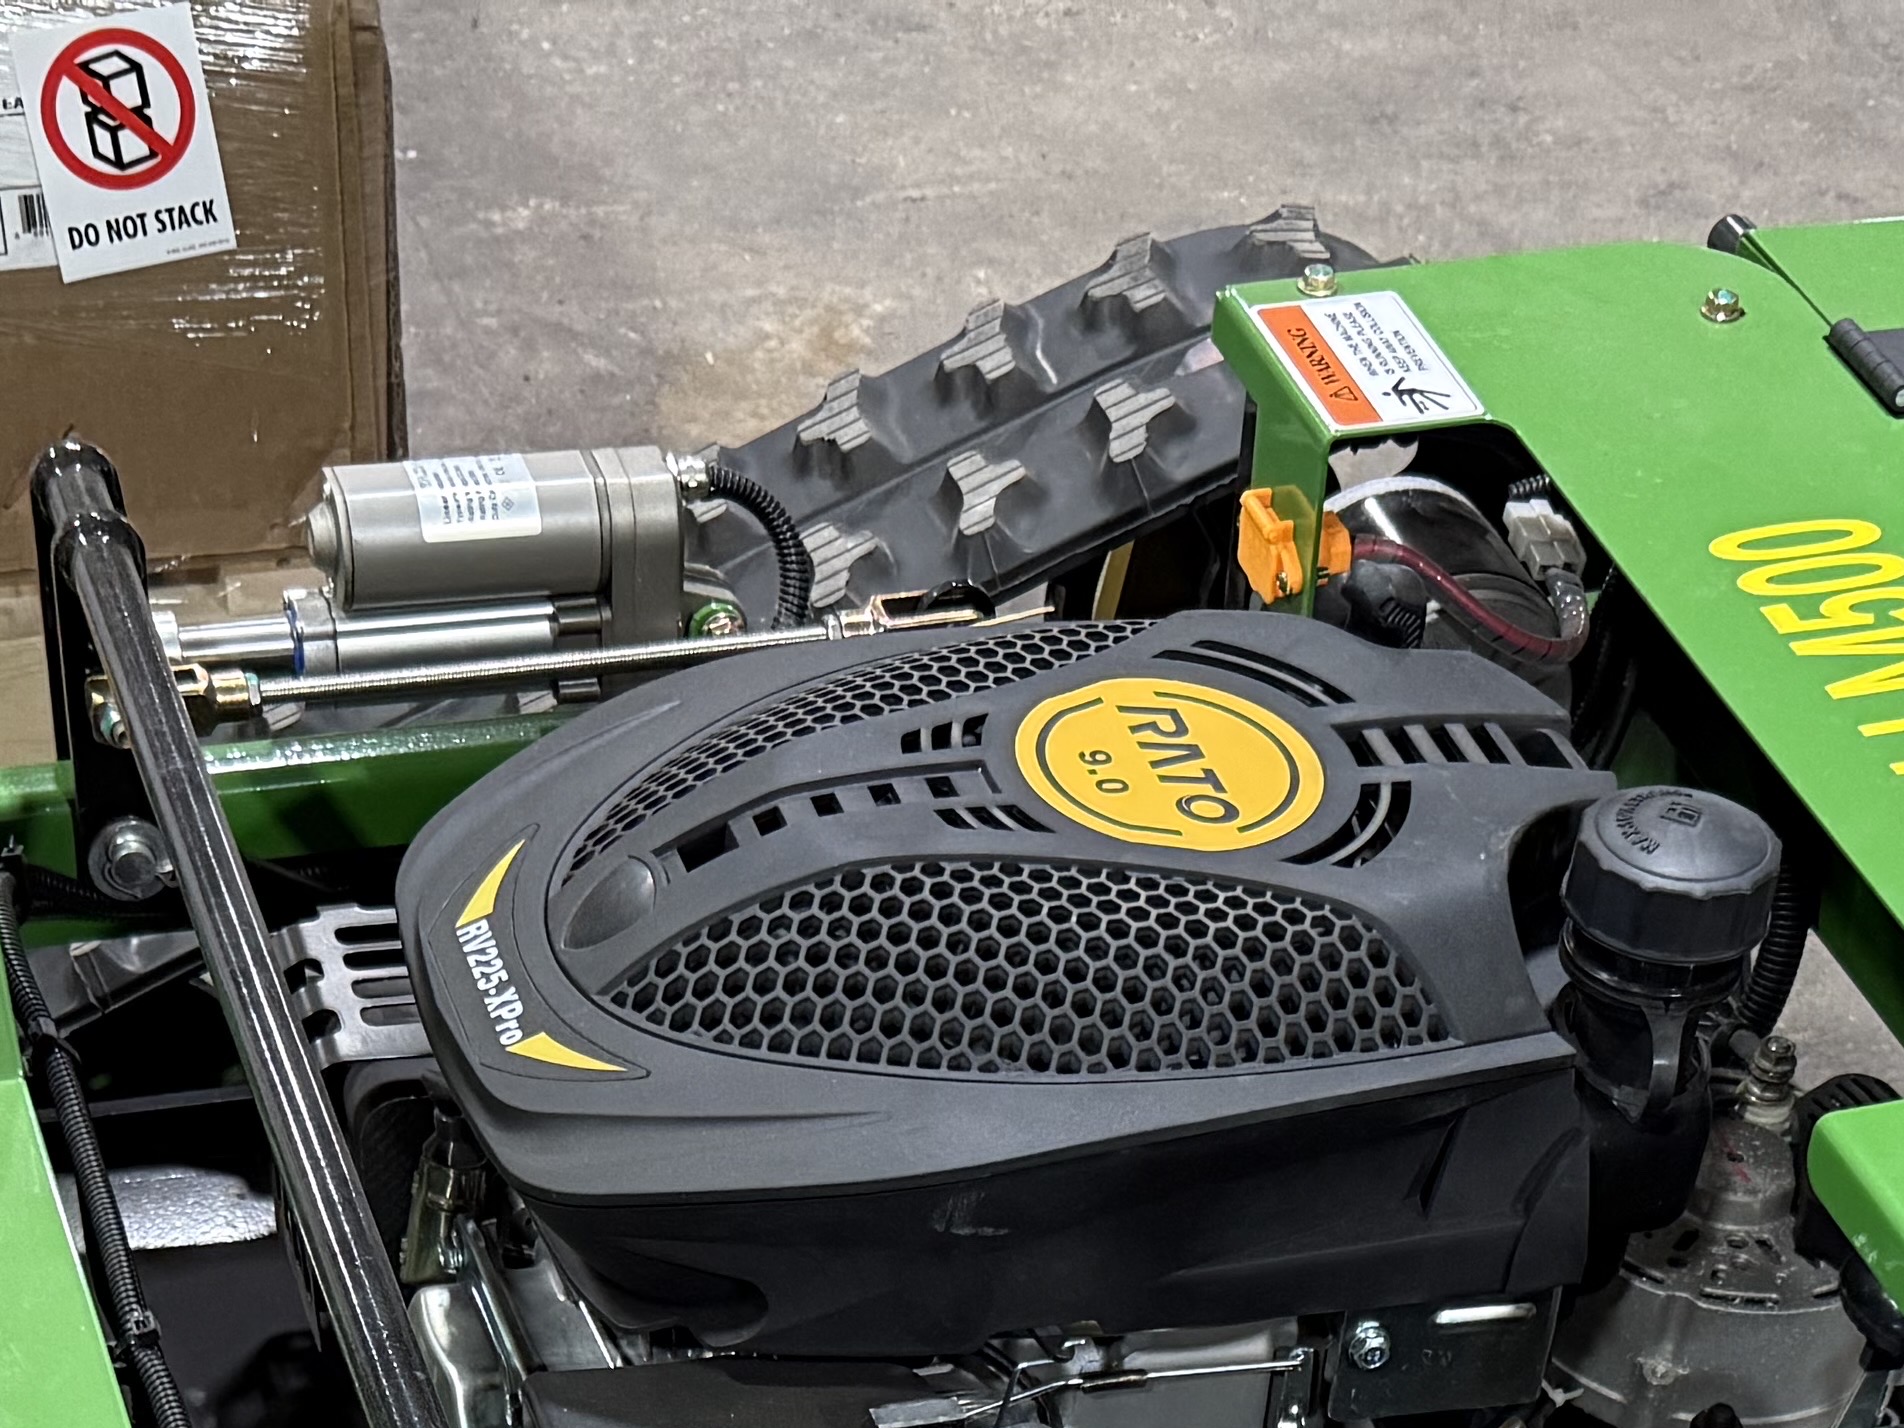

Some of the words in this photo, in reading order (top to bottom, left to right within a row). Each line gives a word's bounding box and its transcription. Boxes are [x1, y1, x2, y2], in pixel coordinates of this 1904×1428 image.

[67, 222, 100, 250] DO
[105, 212, 148, 244] NOT
[154, 199, 218, 234] STACK
[1284, 327, 1343, 385] WARNING
[1078, 749, 1130, 794] 9.0
[1115, 704, 1241, 824] RATO
